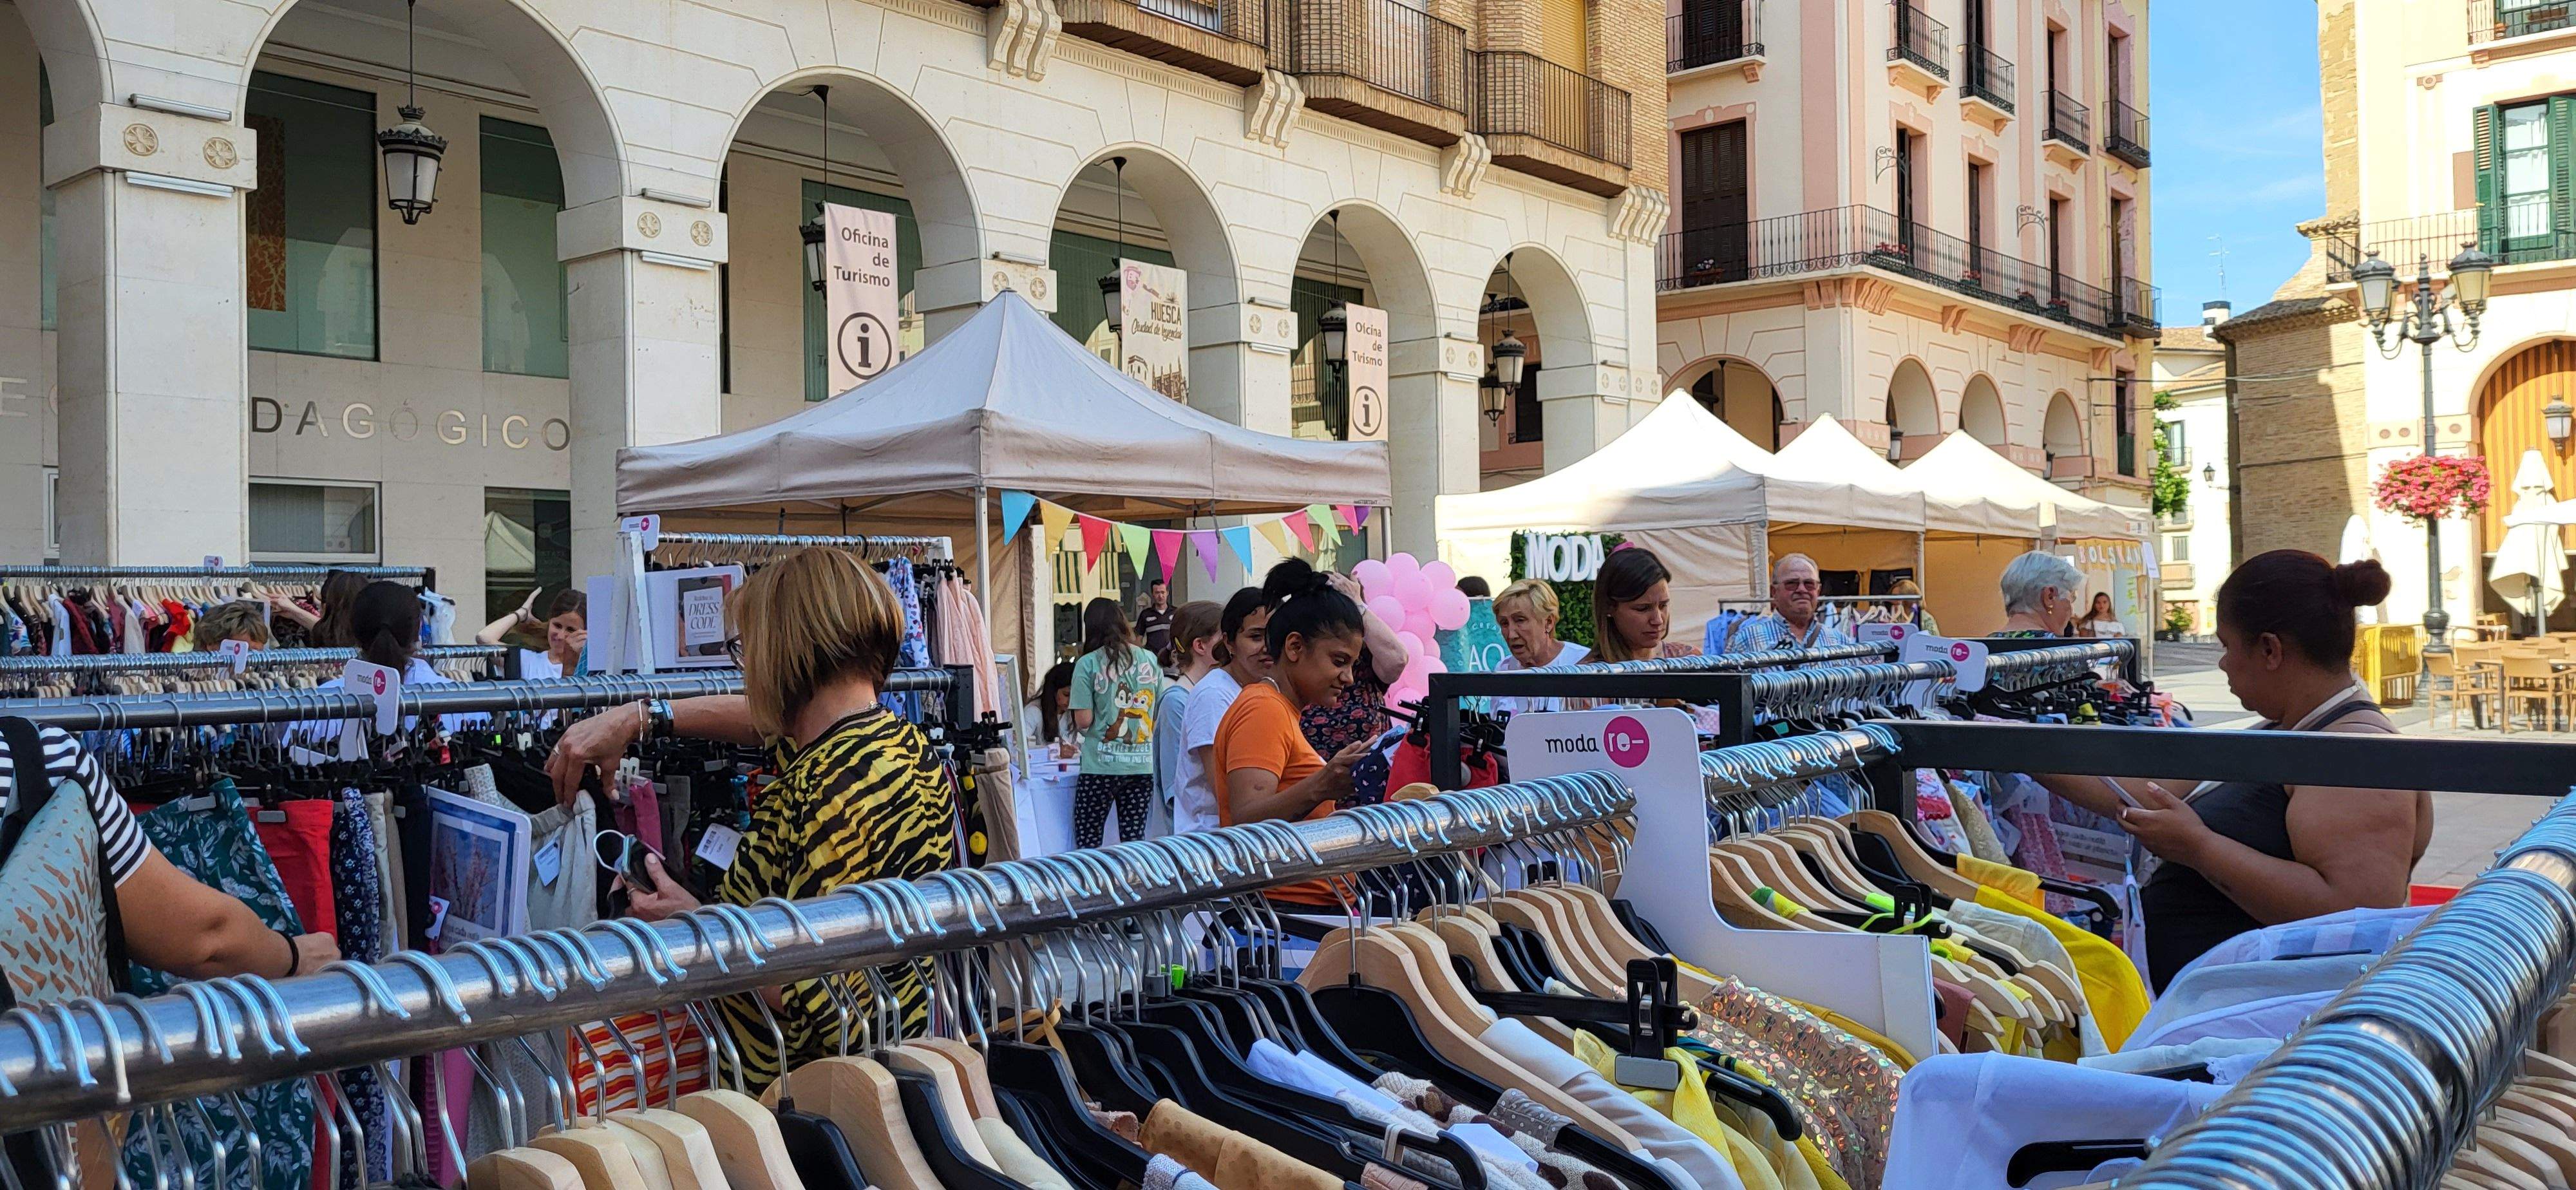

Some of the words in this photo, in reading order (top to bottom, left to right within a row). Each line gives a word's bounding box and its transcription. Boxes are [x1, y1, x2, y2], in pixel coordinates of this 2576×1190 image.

[841, 227, 889, 249] Oficina
[873, 252, 889, 268] de
[833, 265, 890, 287] Turismo
[1150, 301, 1182, 326] HUESCA
[1132, 318, 1153, 335] Ciudad
[1153, 323, 1160, 335] de
[1372, 341, 1383, 352] de
[1524, 532, 1605, 582] MODA
[688, 601, 720, 616] DRESS
[690, 616, 717, 630] CODE
[1925, 645, 1948, 655] moda
[1544, 733, 1600, 753] moda
